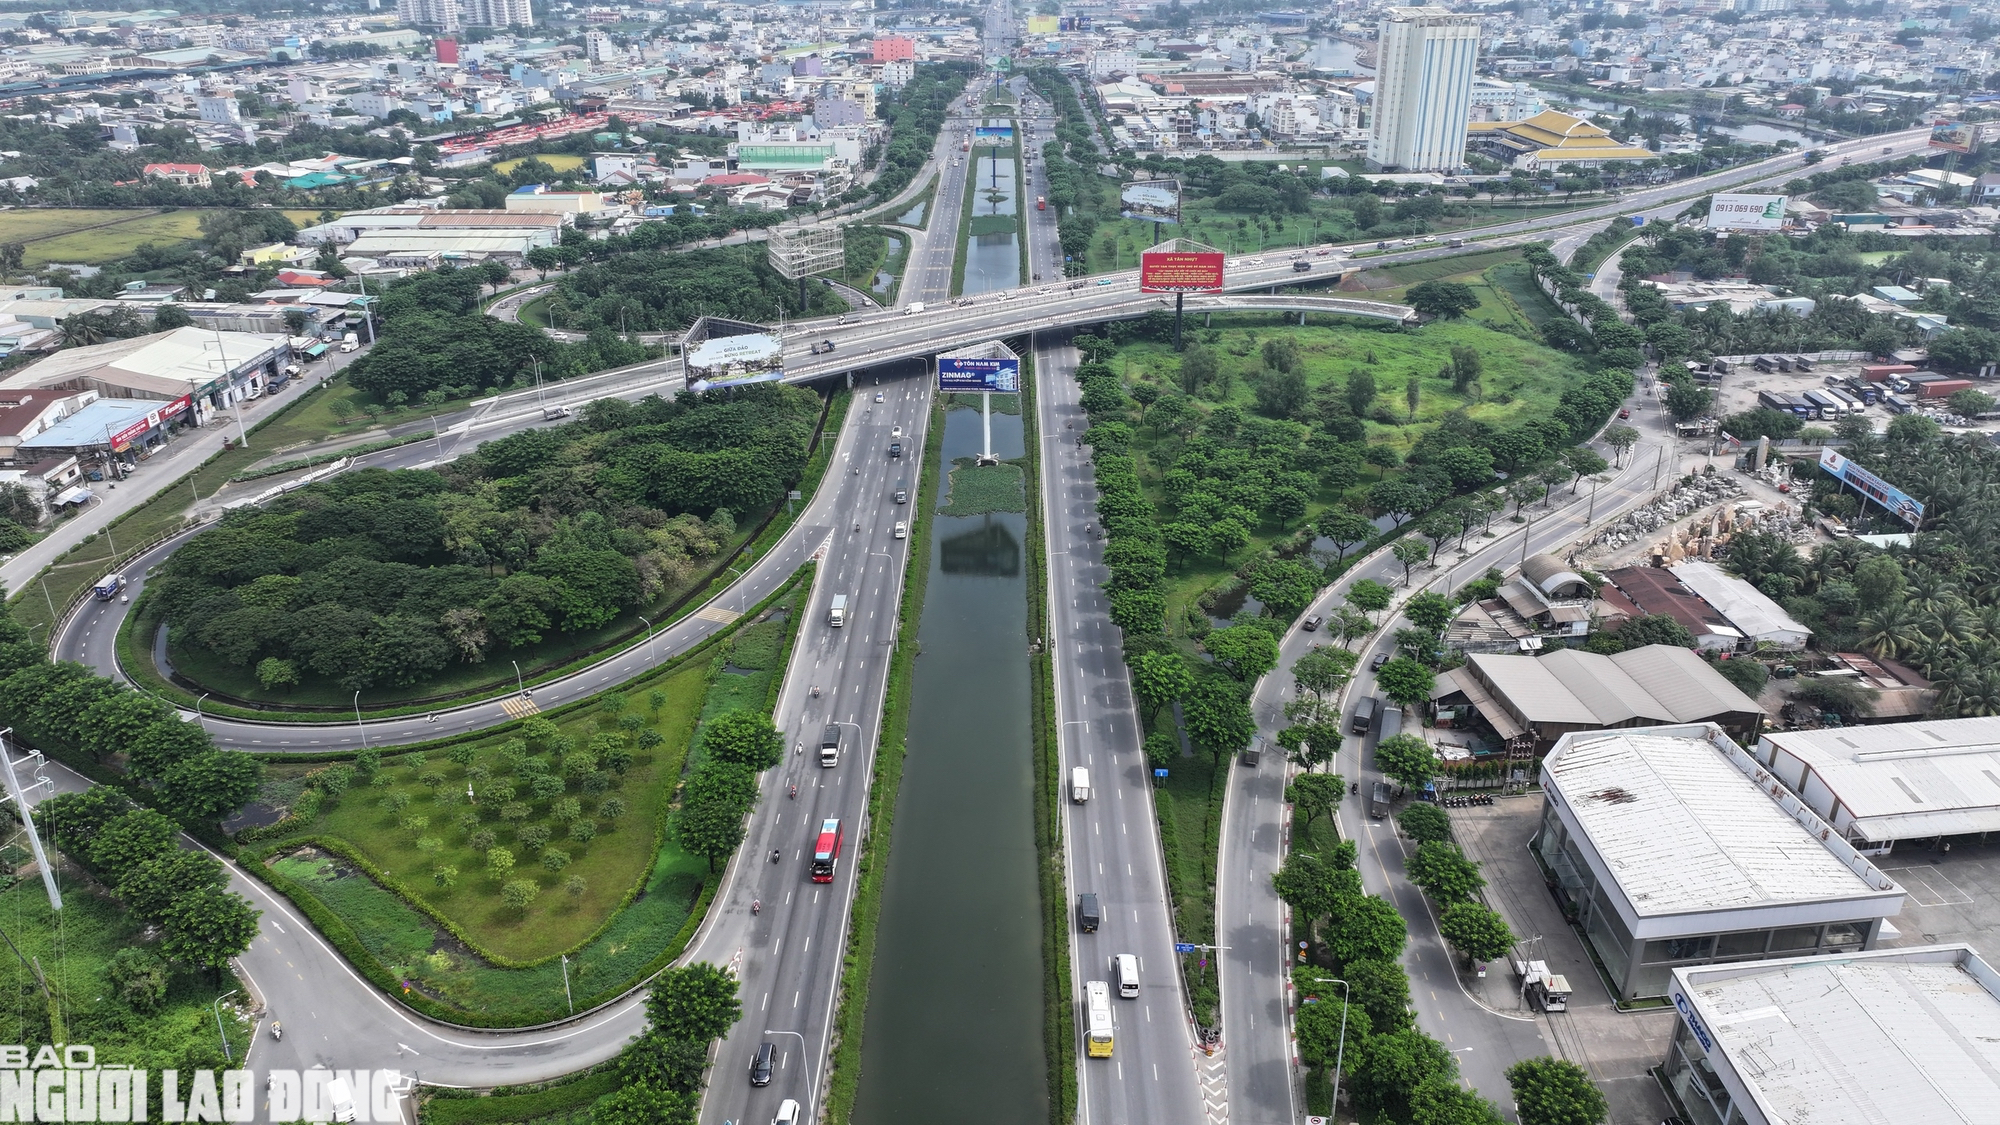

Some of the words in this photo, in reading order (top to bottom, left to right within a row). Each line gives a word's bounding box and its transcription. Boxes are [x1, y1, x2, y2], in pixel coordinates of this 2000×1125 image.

[1715, 204, 1733, 212] 0913
[1734, 204, 1748, 213] 069
[1749, 205, 1763, 213] 690
[1689, 1010, 1711, 1048] THACO
